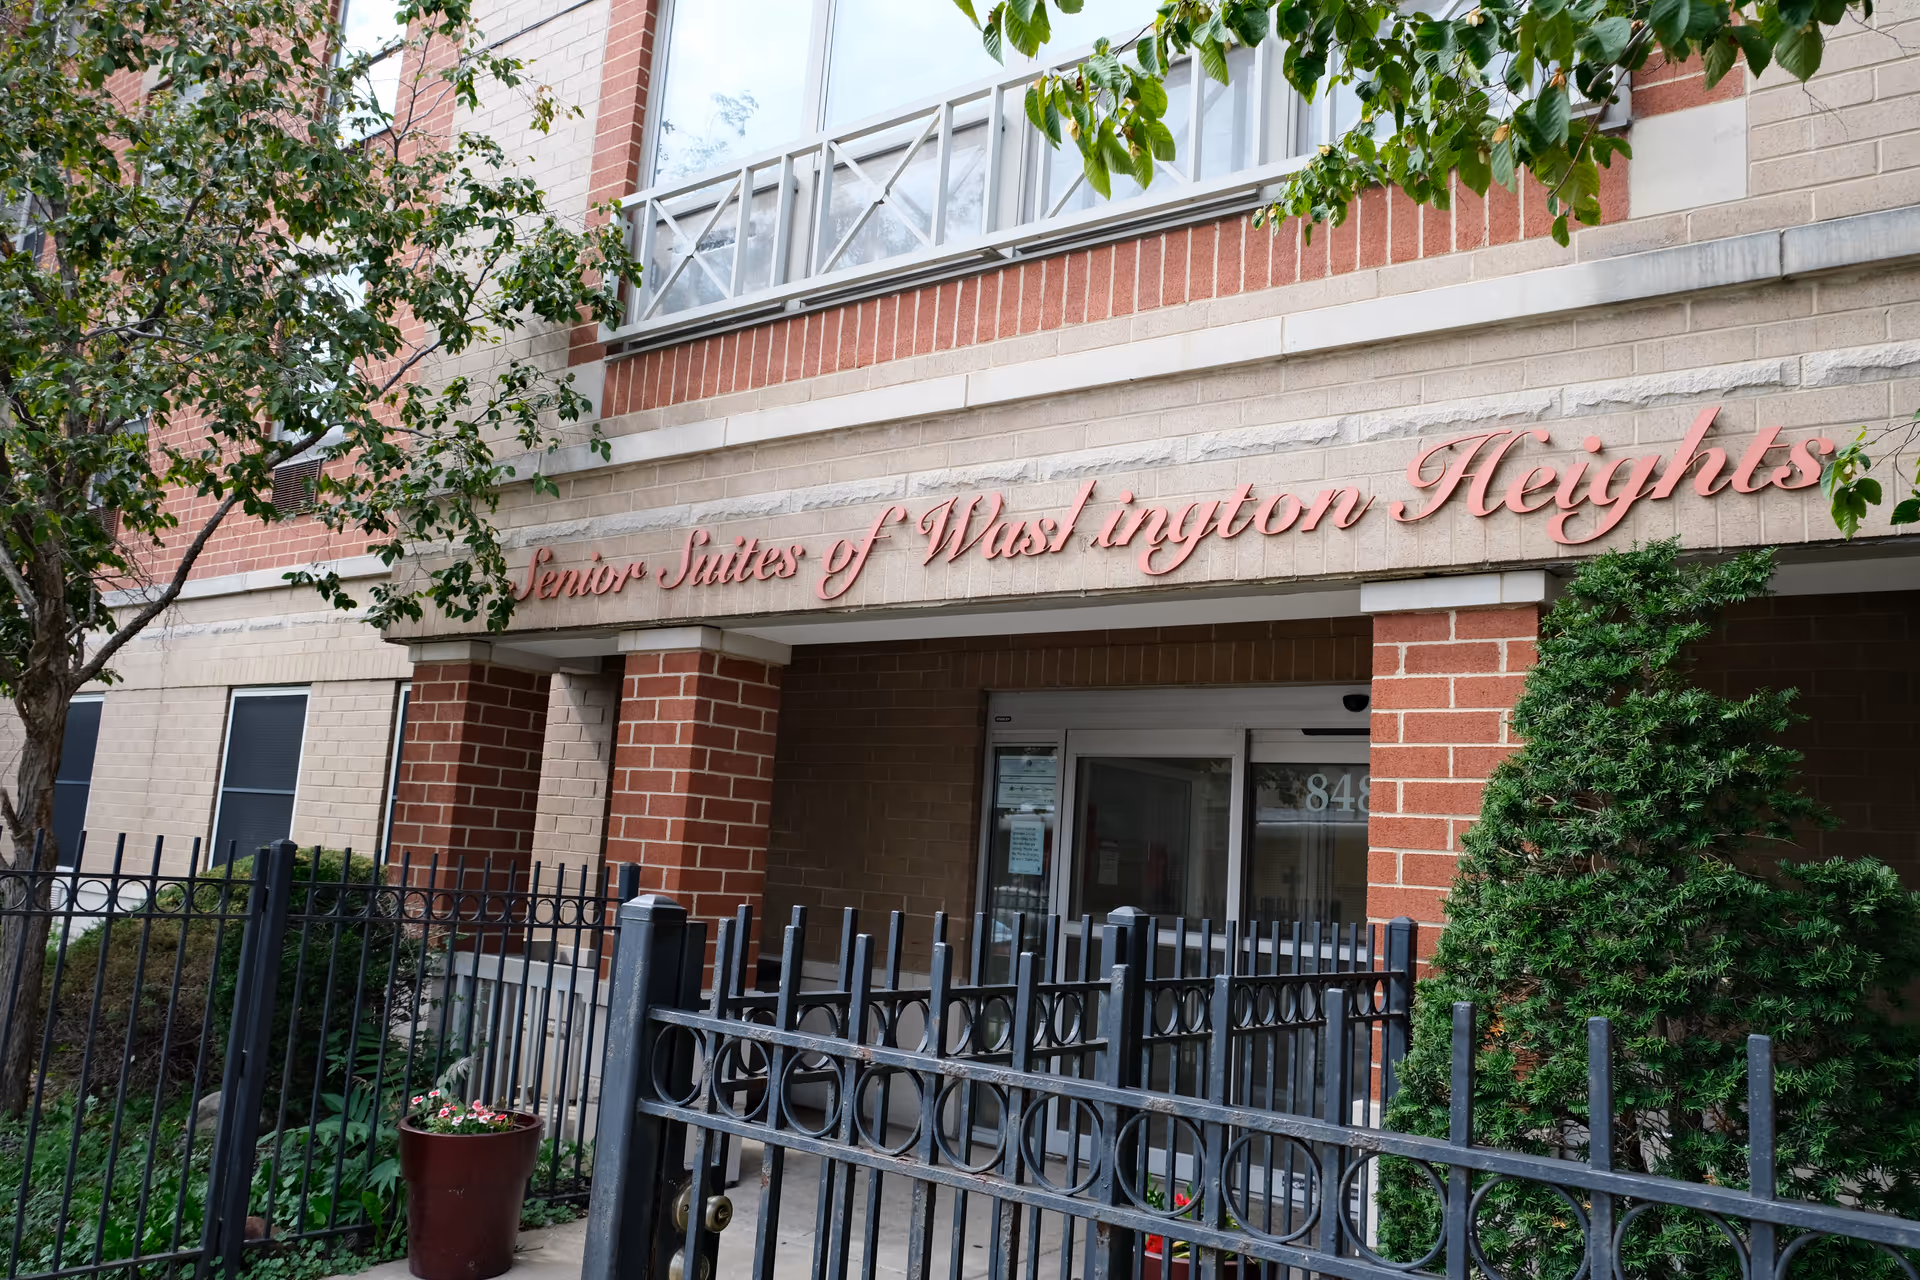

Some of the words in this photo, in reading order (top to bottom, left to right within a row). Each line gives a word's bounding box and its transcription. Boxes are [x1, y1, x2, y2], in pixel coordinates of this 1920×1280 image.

[508, 546, 648, 602] Senior
[656, 529, 805, 590] Suites
[815, 506, 907, 601] of
[1389, 406, 1836, 545] Heights
